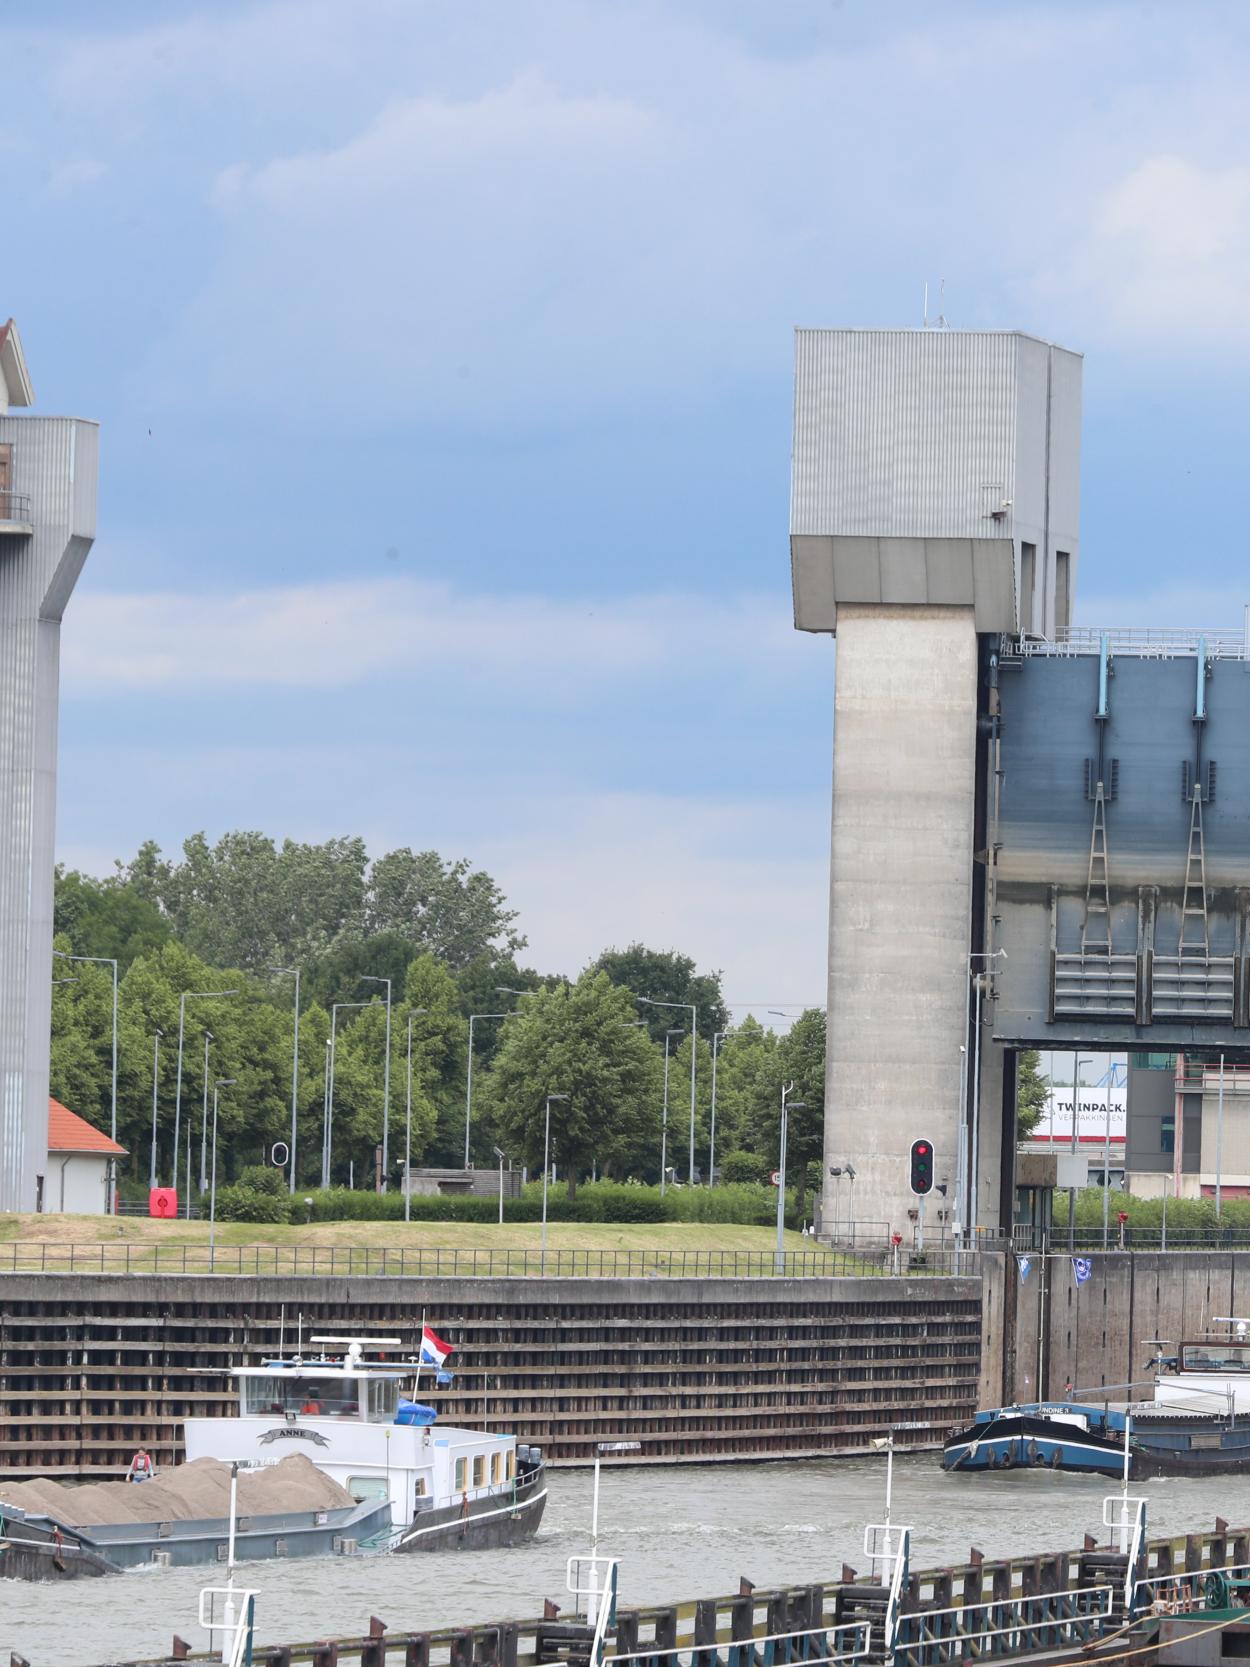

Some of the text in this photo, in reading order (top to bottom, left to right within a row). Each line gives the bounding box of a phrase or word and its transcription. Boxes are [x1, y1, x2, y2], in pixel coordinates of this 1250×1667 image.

[1057, 1102, 1126, 1113] TWINPACK.
[1058, 1113, 1124, 1121] VERPAKKINEN
[279, 1429, 306, 1438] ANNE
